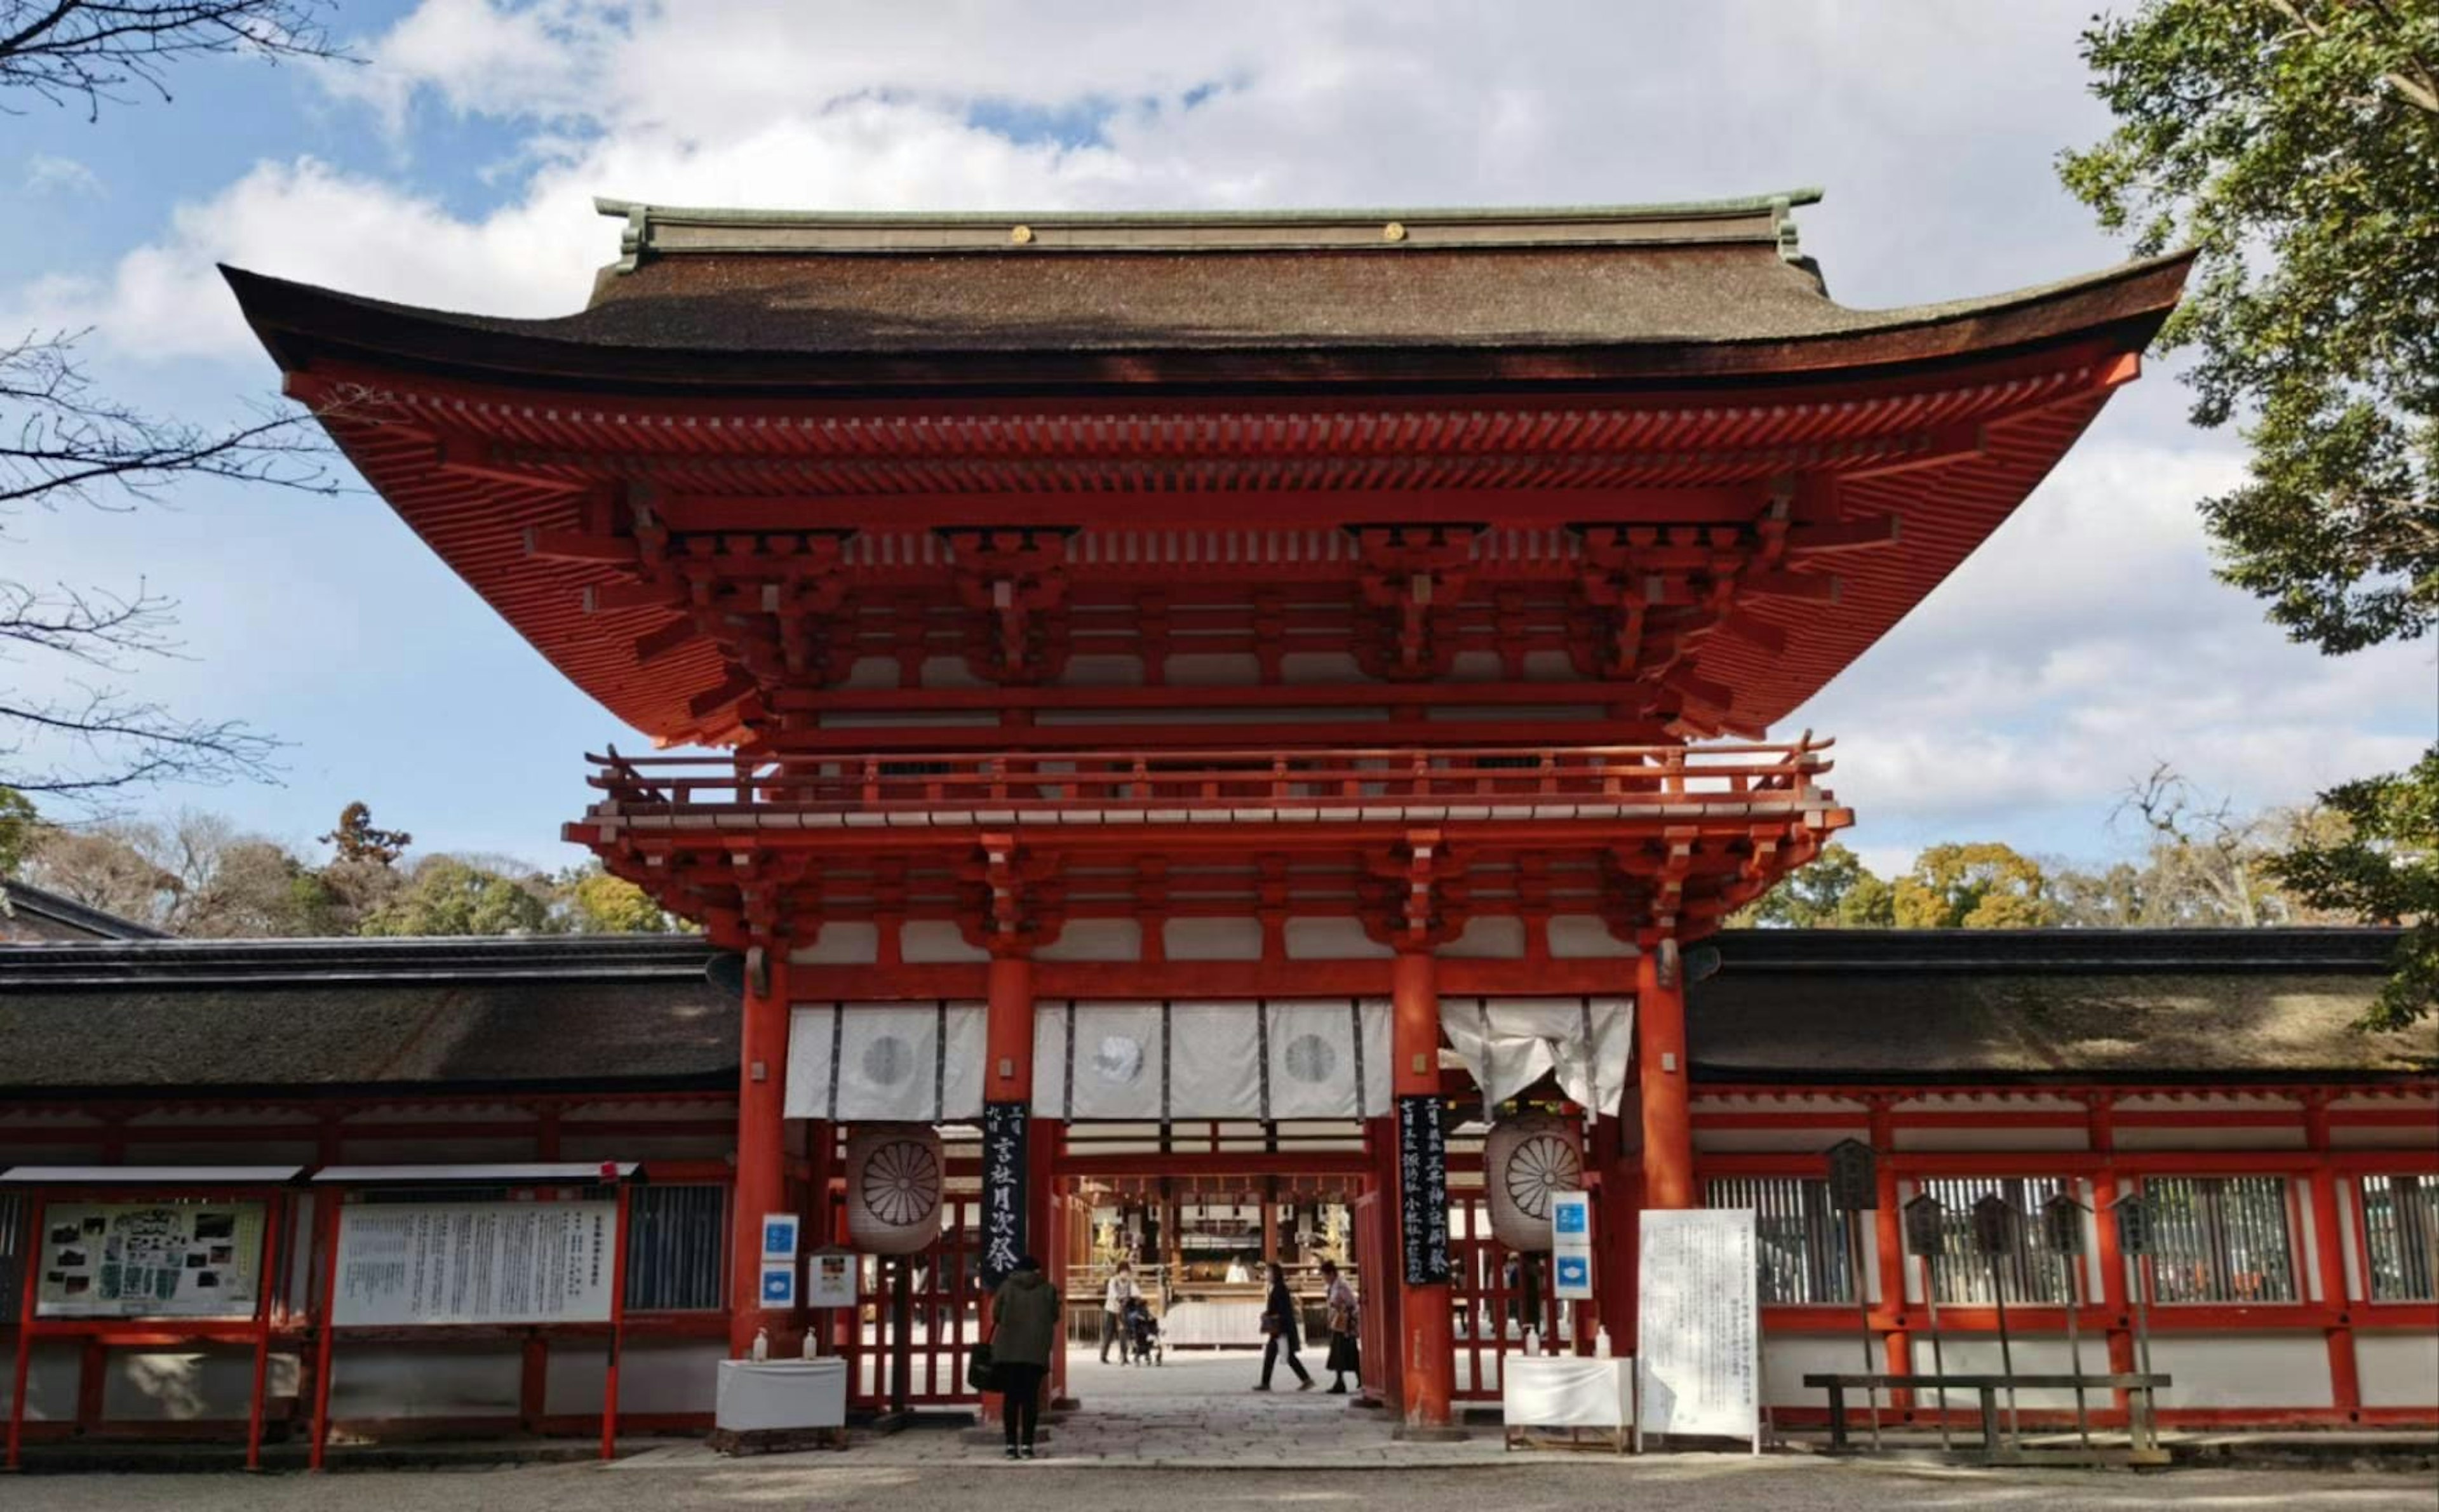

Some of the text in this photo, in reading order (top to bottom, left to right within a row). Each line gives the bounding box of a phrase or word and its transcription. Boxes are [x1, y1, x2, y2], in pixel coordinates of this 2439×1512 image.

[986, 1137, 1018, 1272] 言社月次祭
